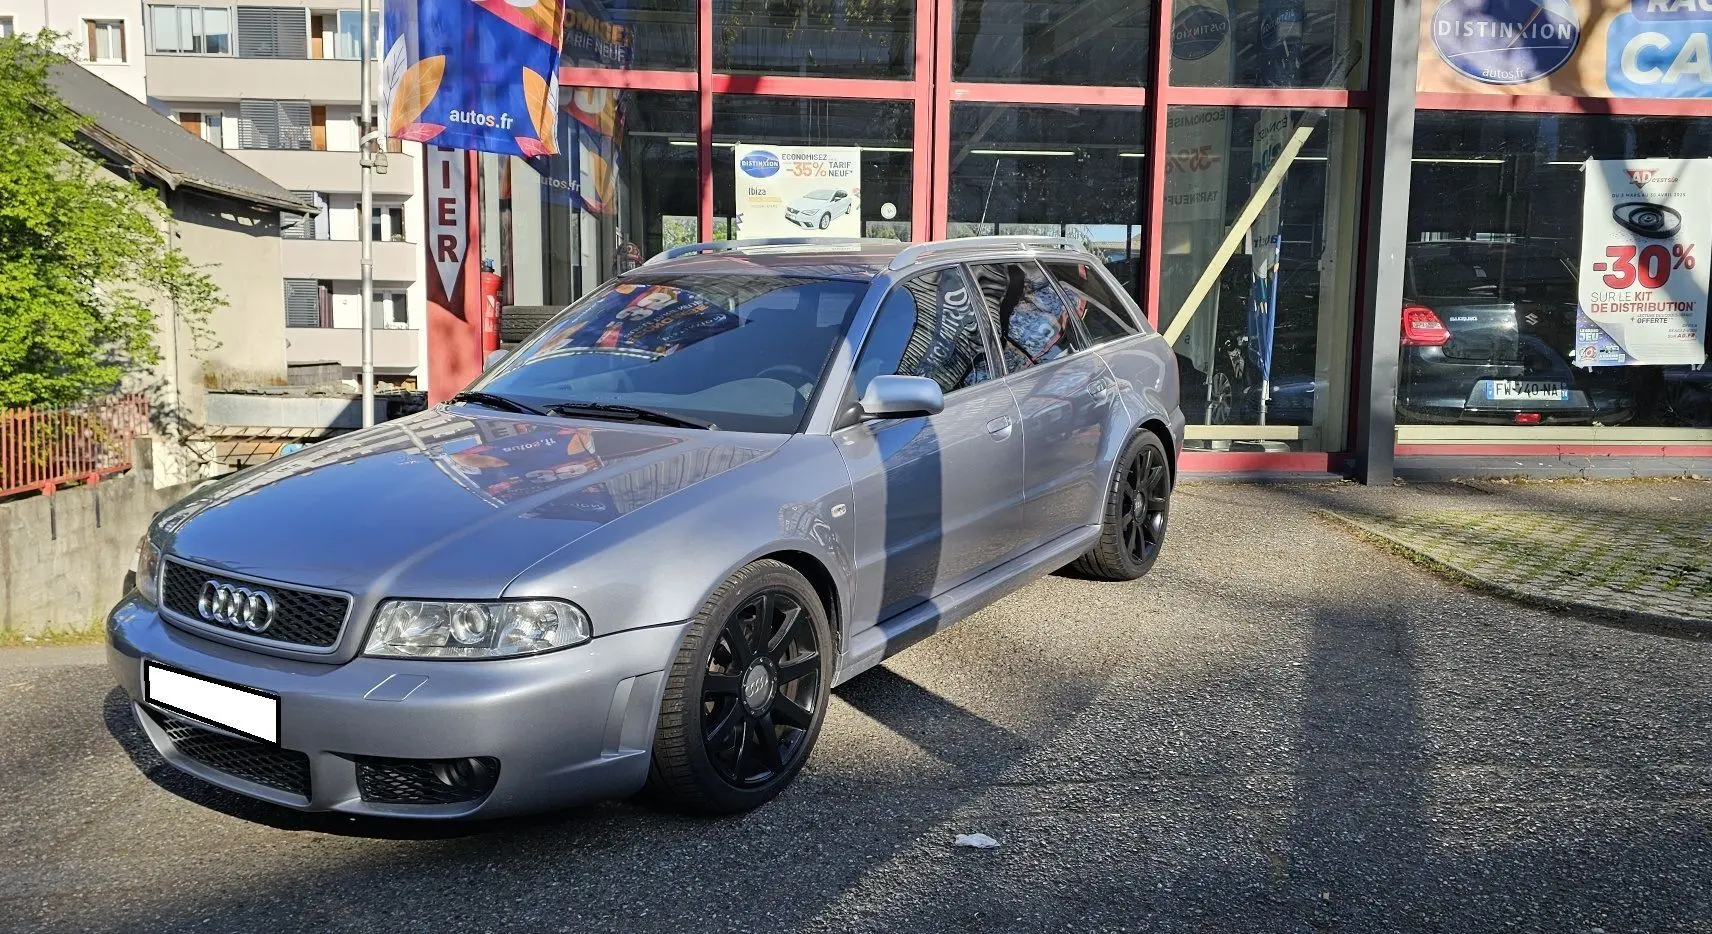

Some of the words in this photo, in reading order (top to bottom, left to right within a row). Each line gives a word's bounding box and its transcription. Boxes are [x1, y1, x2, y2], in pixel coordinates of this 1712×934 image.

[1438, 19, 1572, 40] DISTINXION
[1481, 66, 1525, 79] autos.fr
[449, 108, 514, 130] autos.fr
[741, 159, 779, 168] DISTINXION
[786, 162, 827, 177] -35%
[829, 161, 852, 169] TARIF
[748, 187, 767, 196] Ibiza
[438, 144, 459, 264] IER
[1593, 243, 1695, 290] -30%
[1590, 291, 1616, 302] SUR
[1619, 291, 1632, 301] LE
[1634, 291, 1653, 301] KIT
[1590, 303, 1608, 313] DE
[1579, 333, 1599, 342] JEU
